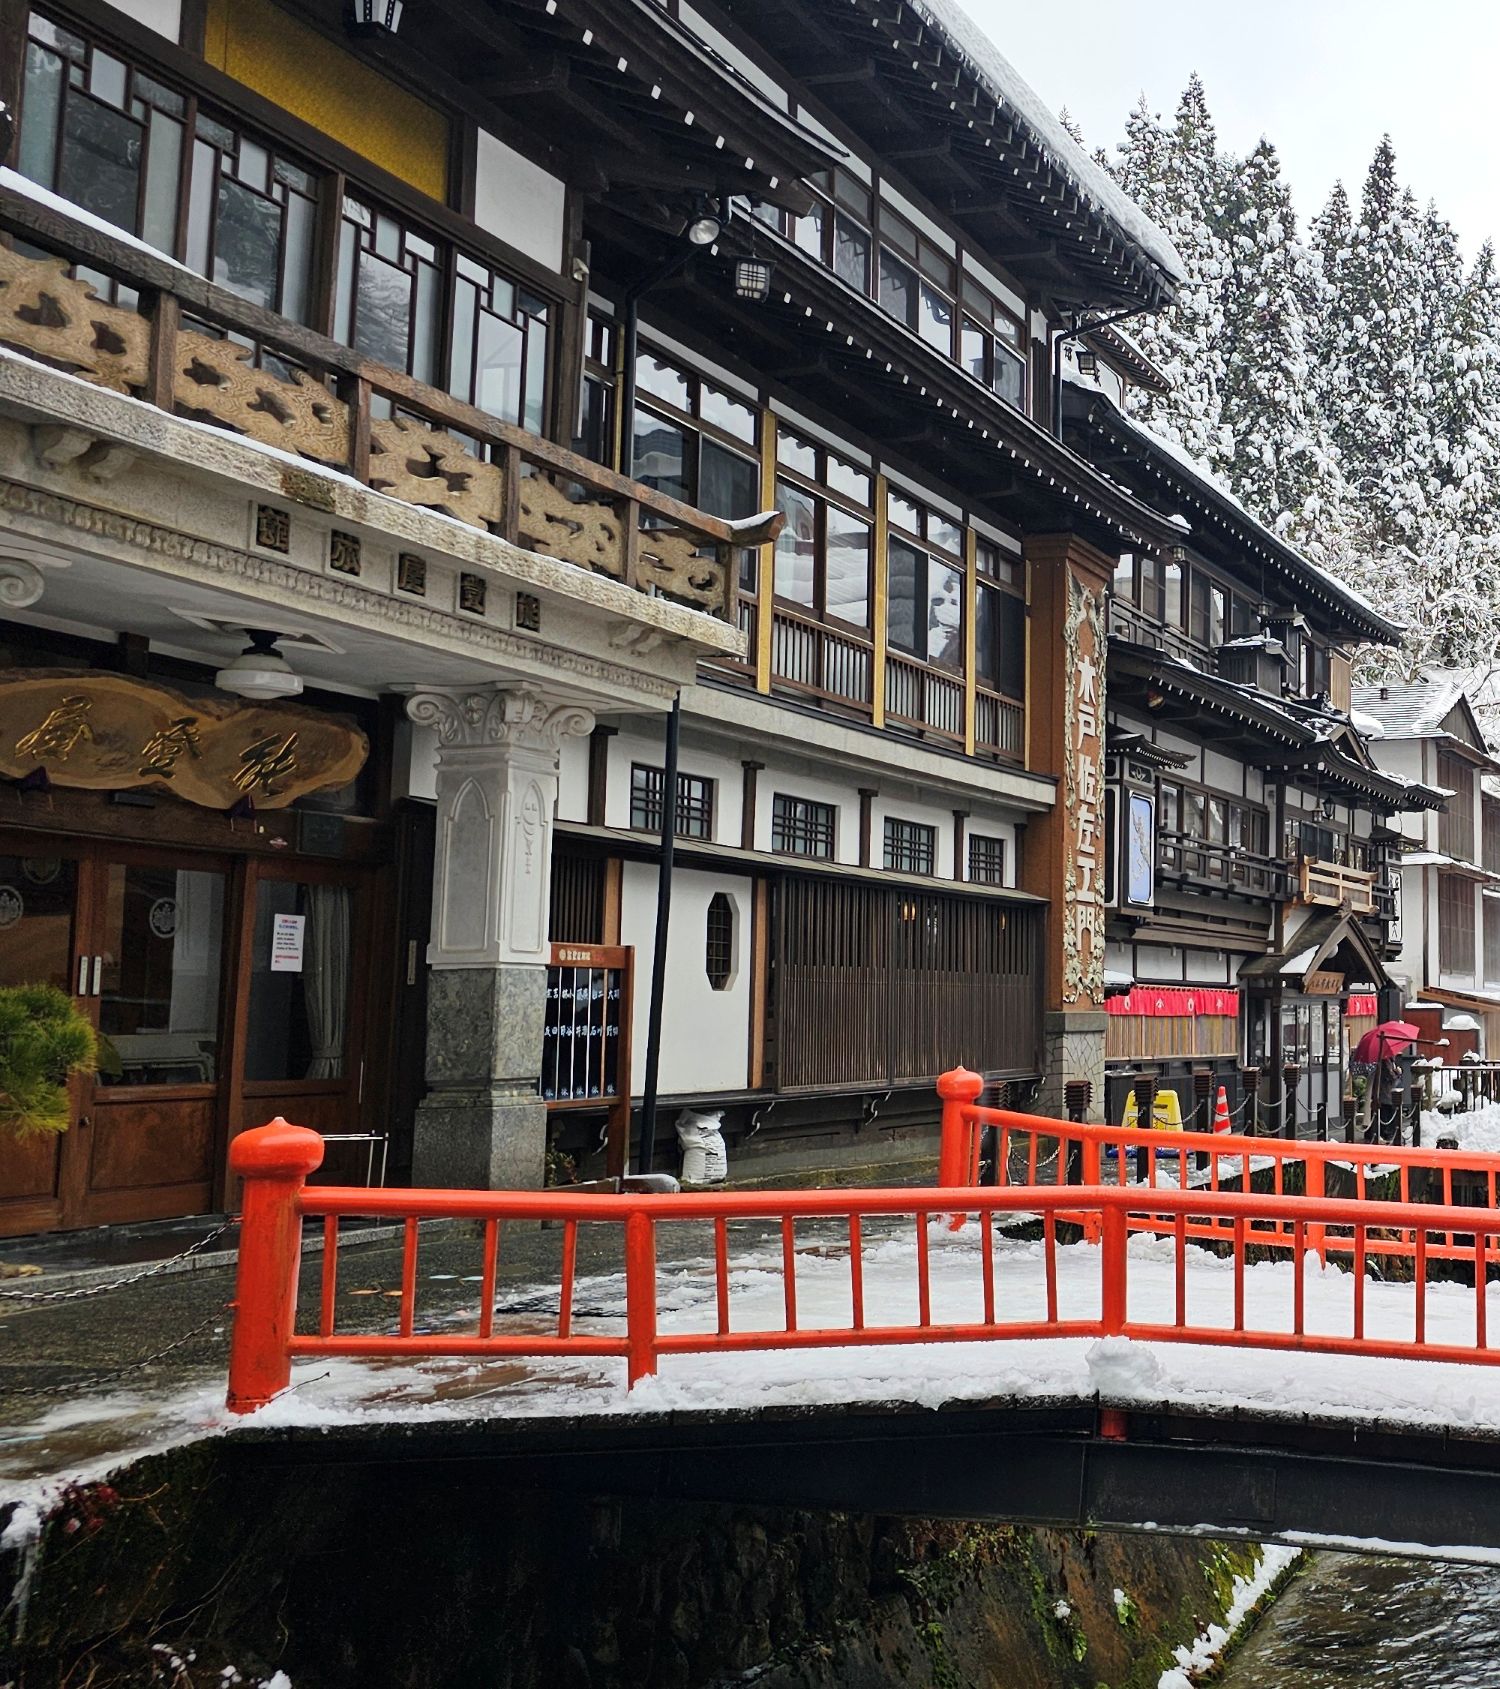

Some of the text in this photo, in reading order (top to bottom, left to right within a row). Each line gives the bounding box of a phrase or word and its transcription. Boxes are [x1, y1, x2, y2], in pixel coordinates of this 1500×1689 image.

[1076, 654, 1097, 952] 木戸佐左エ門
